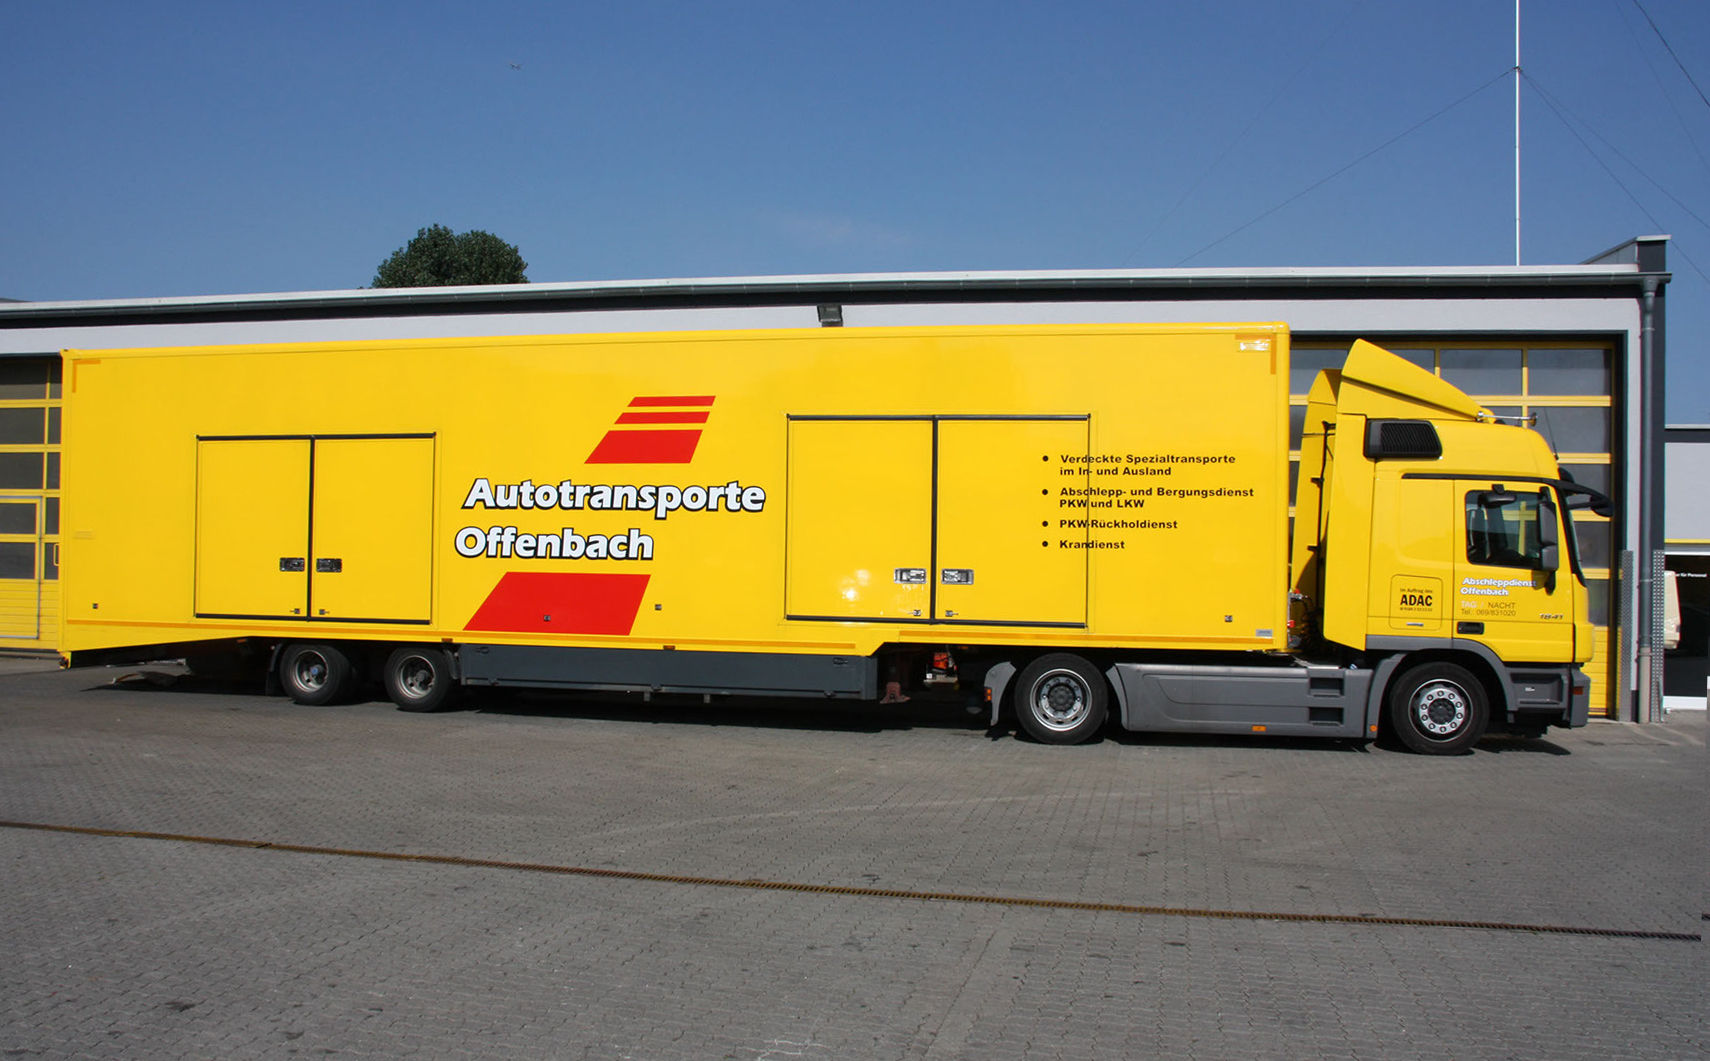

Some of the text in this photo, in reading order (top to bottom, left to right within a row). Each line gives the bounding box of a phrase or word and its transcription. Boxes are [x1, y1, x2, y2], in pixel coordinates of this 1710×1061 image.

[1060, 454, 1236, 465] Verdeckte Spezialtransporte
[1060, 467, 1074, 476] im
[1096, 467, 1119, 476] und
[1122, 467, 1172, 476] Ausland
[1060, 487, 1254, 498] Abschlepp- und Bergungsdienst
[461, 478, 766, 520] Autotransporte
[1059, 499, 1145, 508] PKW und LKW
[1059, 519, 1178, 529] PKW-Rückholdienst
[454, 526, 655, 560] Offenbach
[1059, 540, 1125, 549] Krandienst
[1462, 577, 1537, 588] Abschleppdienst
[1460, 587, 1509, 596] Offenbach
[1400, 594, 1433, 607] ADAC
[1461, 600, 1477, 608] TAG
[1487, 601, 1516, 609] NACHT
